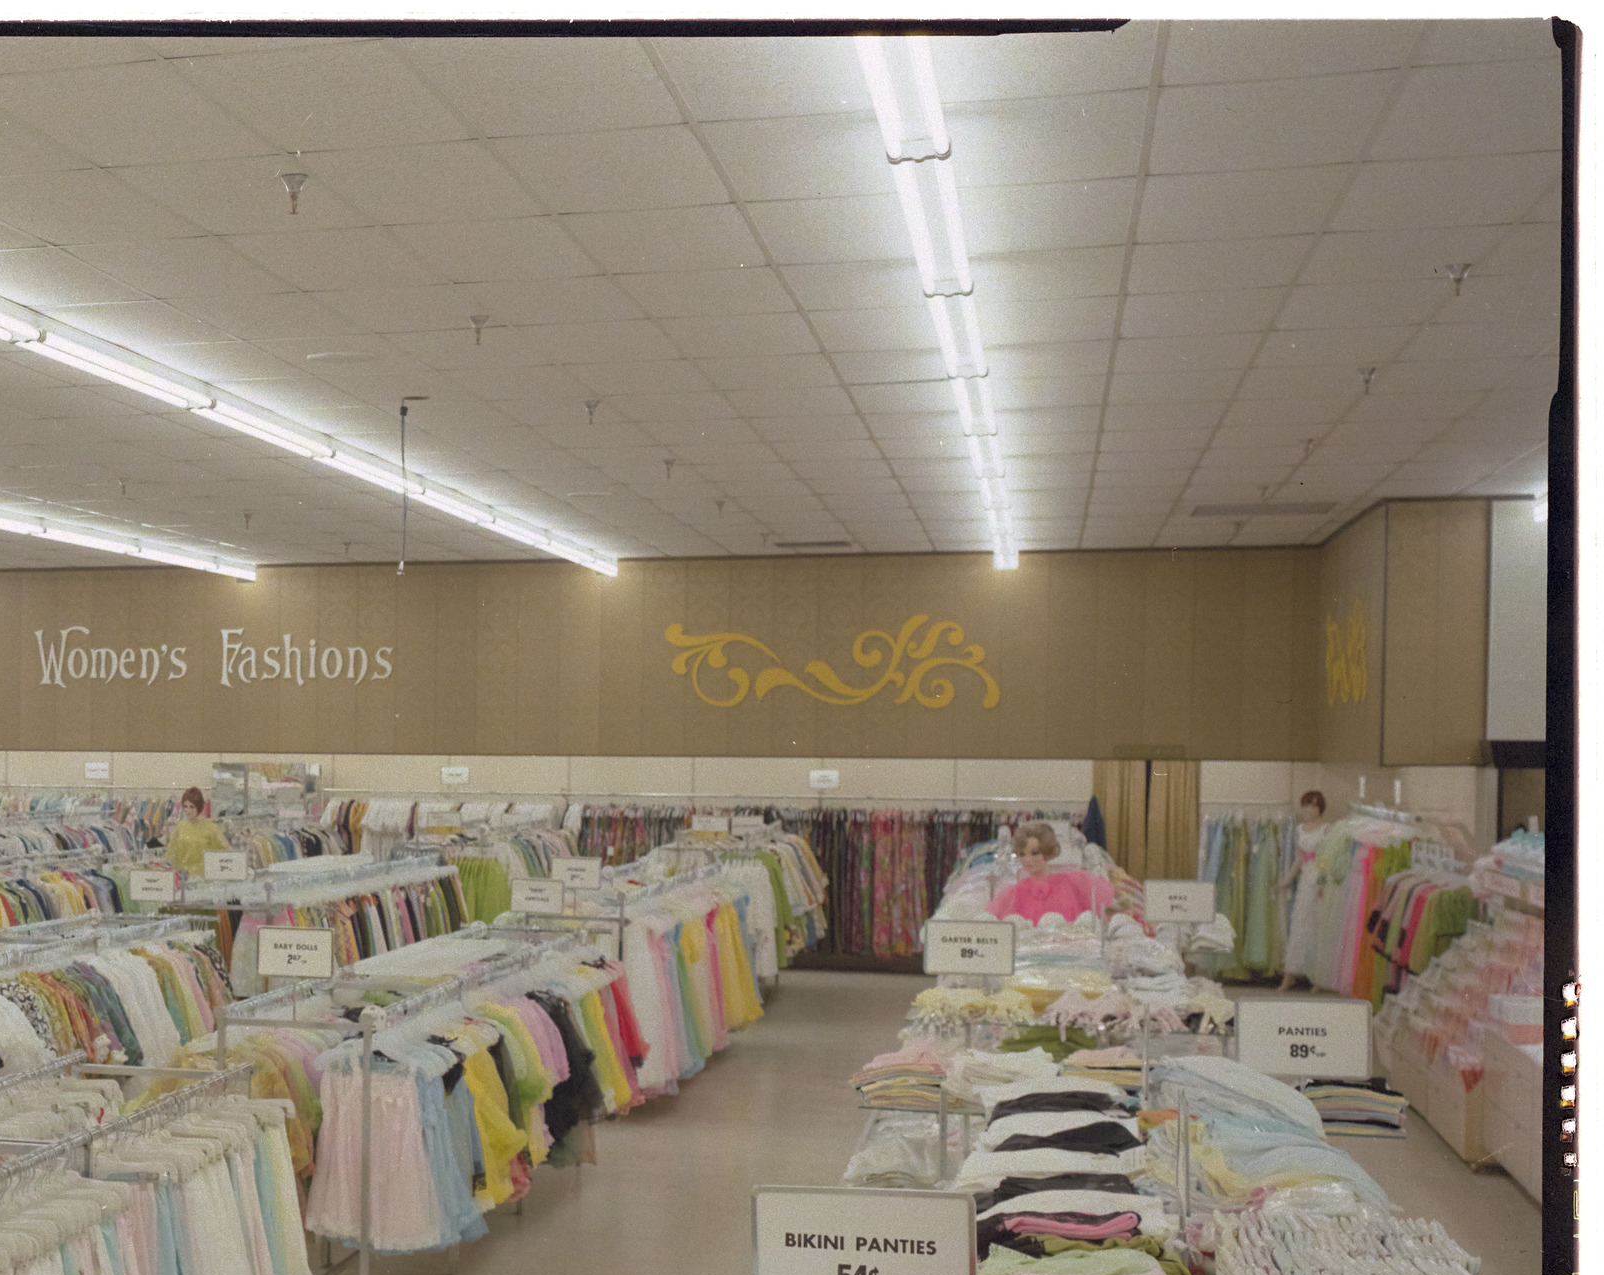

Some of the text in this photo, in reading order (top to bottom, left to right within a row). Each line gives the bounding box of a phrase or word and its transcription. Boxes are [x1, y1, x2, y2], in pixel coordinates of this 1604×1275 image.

[34, 625, 394, 687] Women's Fashions
[941, 936, 998, 945] GARTER BELTS
[296, 944, 318, 952] DOLLS
[1278, 1027, 1327, 1037] PANTIES
[785, 1232, 937, 1255] BIKINI PANTIES
